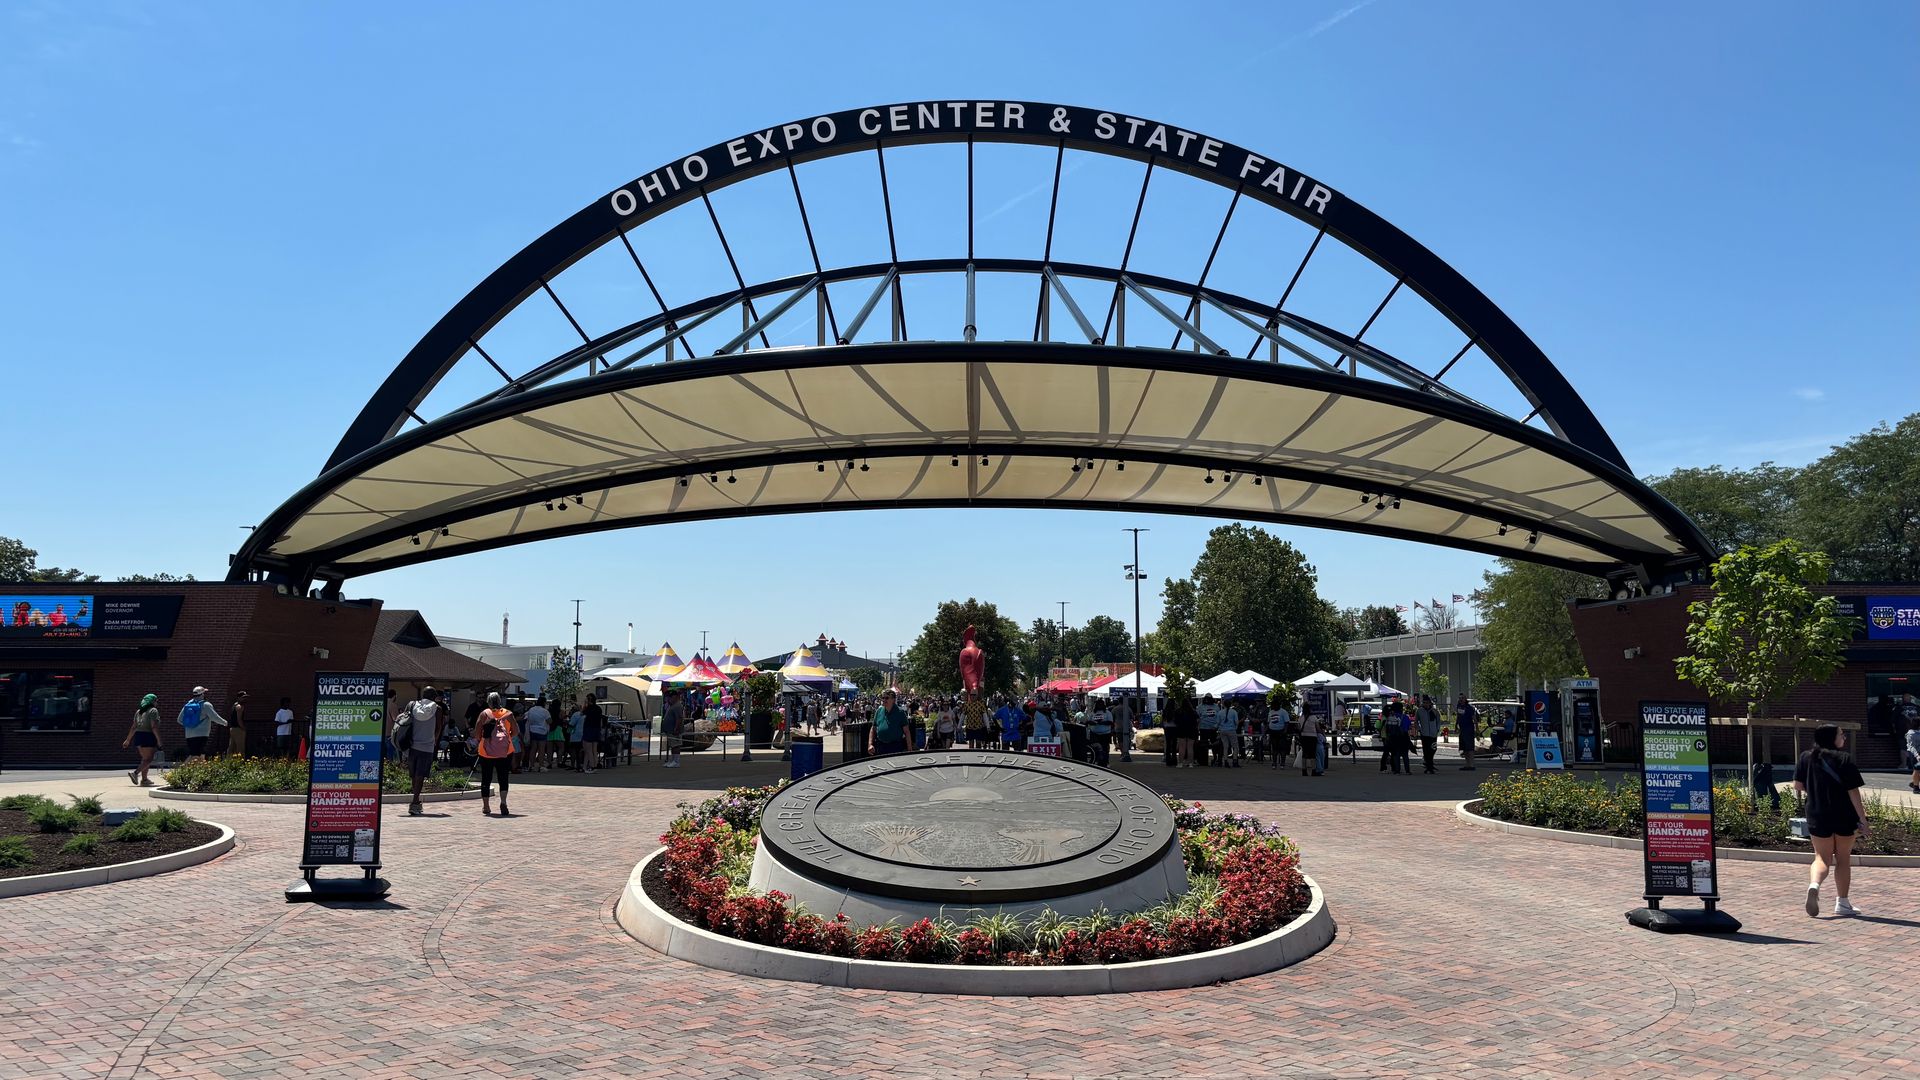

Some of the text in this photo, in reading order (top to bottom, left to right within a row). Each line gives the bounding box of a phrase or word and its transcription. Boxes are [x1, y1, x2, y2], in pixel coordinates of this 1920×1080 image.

[610, 102, 1333, 216] OHIO EXPO CENTER & STATE FAIR
[1898, 619, 1920, 627] MER
[318, 677, 340, 685] OHIO
[341, 677, 366, 685] STATE
[318, 685, 385, 695] WELCOME
[1643, 706, 1706, 715] OHIO STATE FAIR
[316, 714, 367, 722] SECURITY
[1643, 714, 1706, 725] WELCOME
[315, 722, 351, 730] CHECK
[1644, 744, 1692, 752] SECURITY
[314, 750, 353, 758] ONLINE
[1645, 751, 1677, 760] CHECK
[1661, 773, 1693, 781] TICKETS
[1646, 779, 1681, 788] ONLINE
[311, 798, 376, 806] HANDSTAMP
[777, 755, 1158, 864] THE GREAT SEAL OF THE STATE OF OHIO
[1648, 828, 1709, 837] HANDSTAMP
